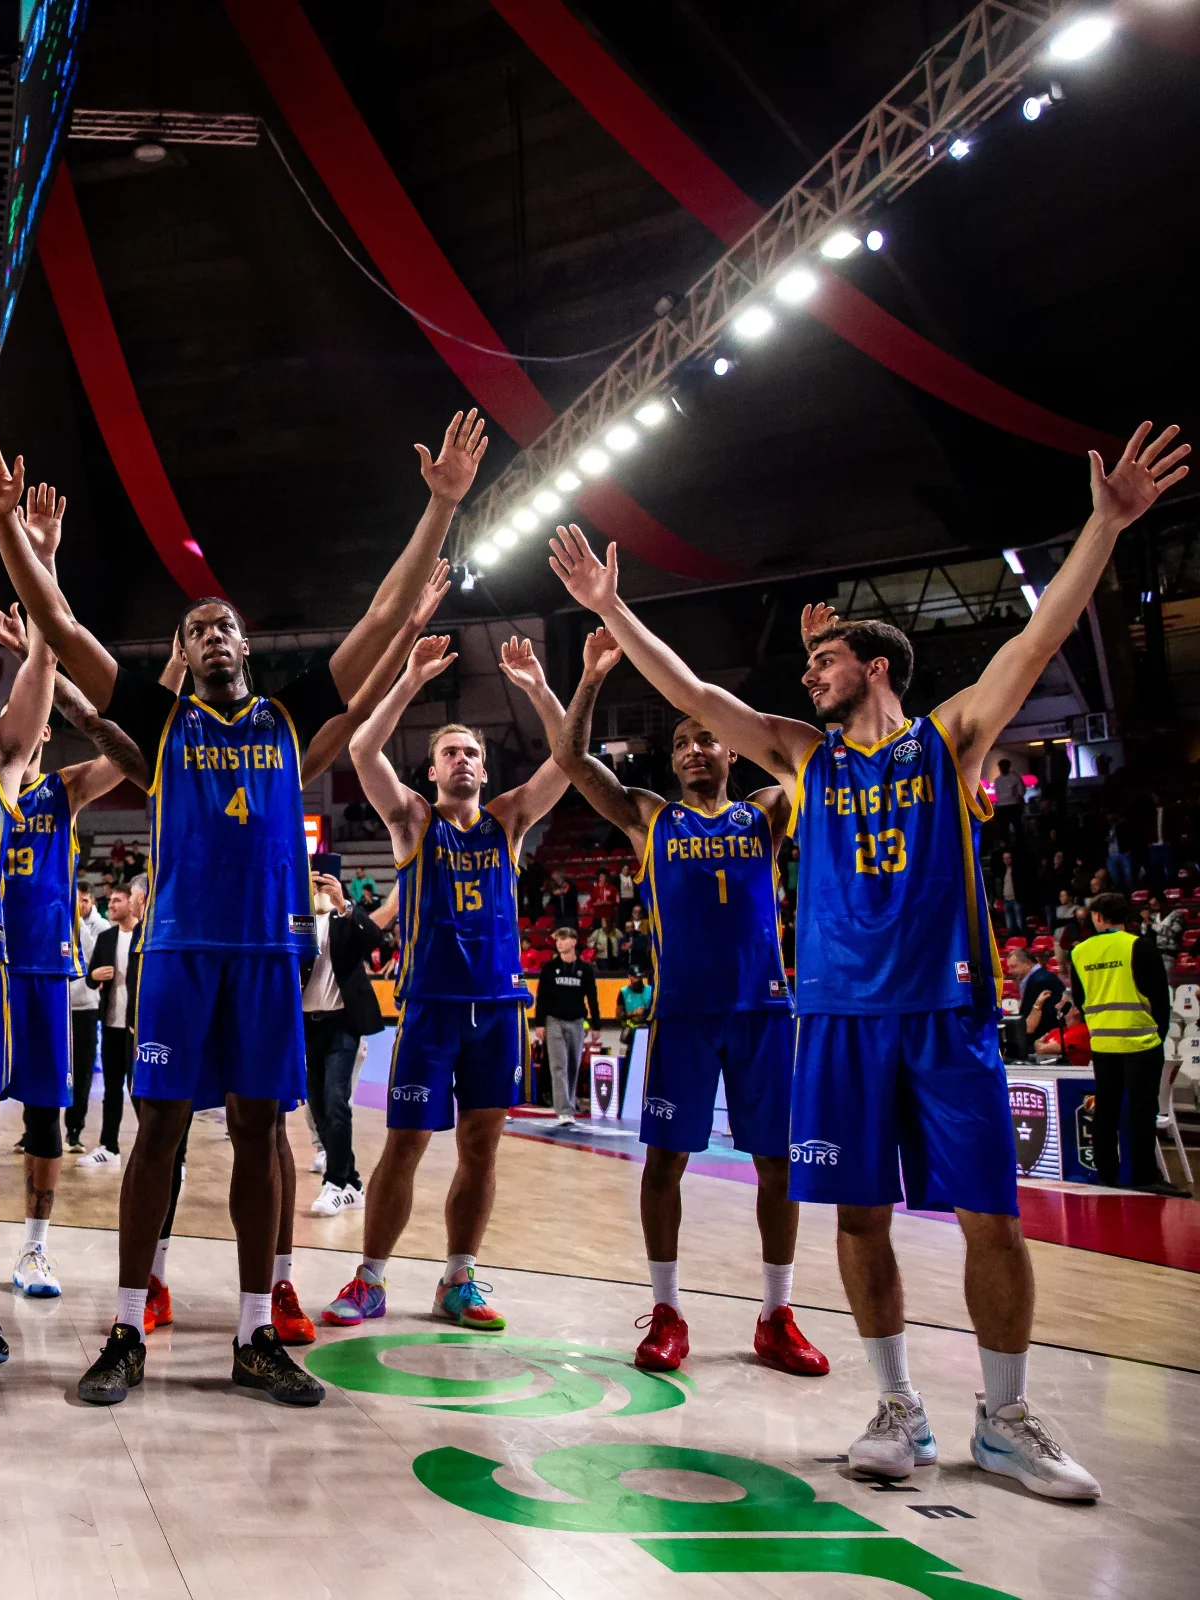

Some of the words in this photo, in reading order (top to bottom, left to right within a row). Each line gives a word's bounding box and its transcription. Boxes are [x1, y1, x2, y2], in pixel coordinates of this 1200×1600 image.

[184, 744, 284, 770] PERISTERI
[224, 787, 249, 825] 4
[7, 847, 34, 876] 19
[855, 828, 907, 875] 23
[454, 879, 483, 912] 15
[715, 869, 728, 904] 1
[393, 1090, 429, 1103] OURS
[790, 1149, 839, 1166] OURS
